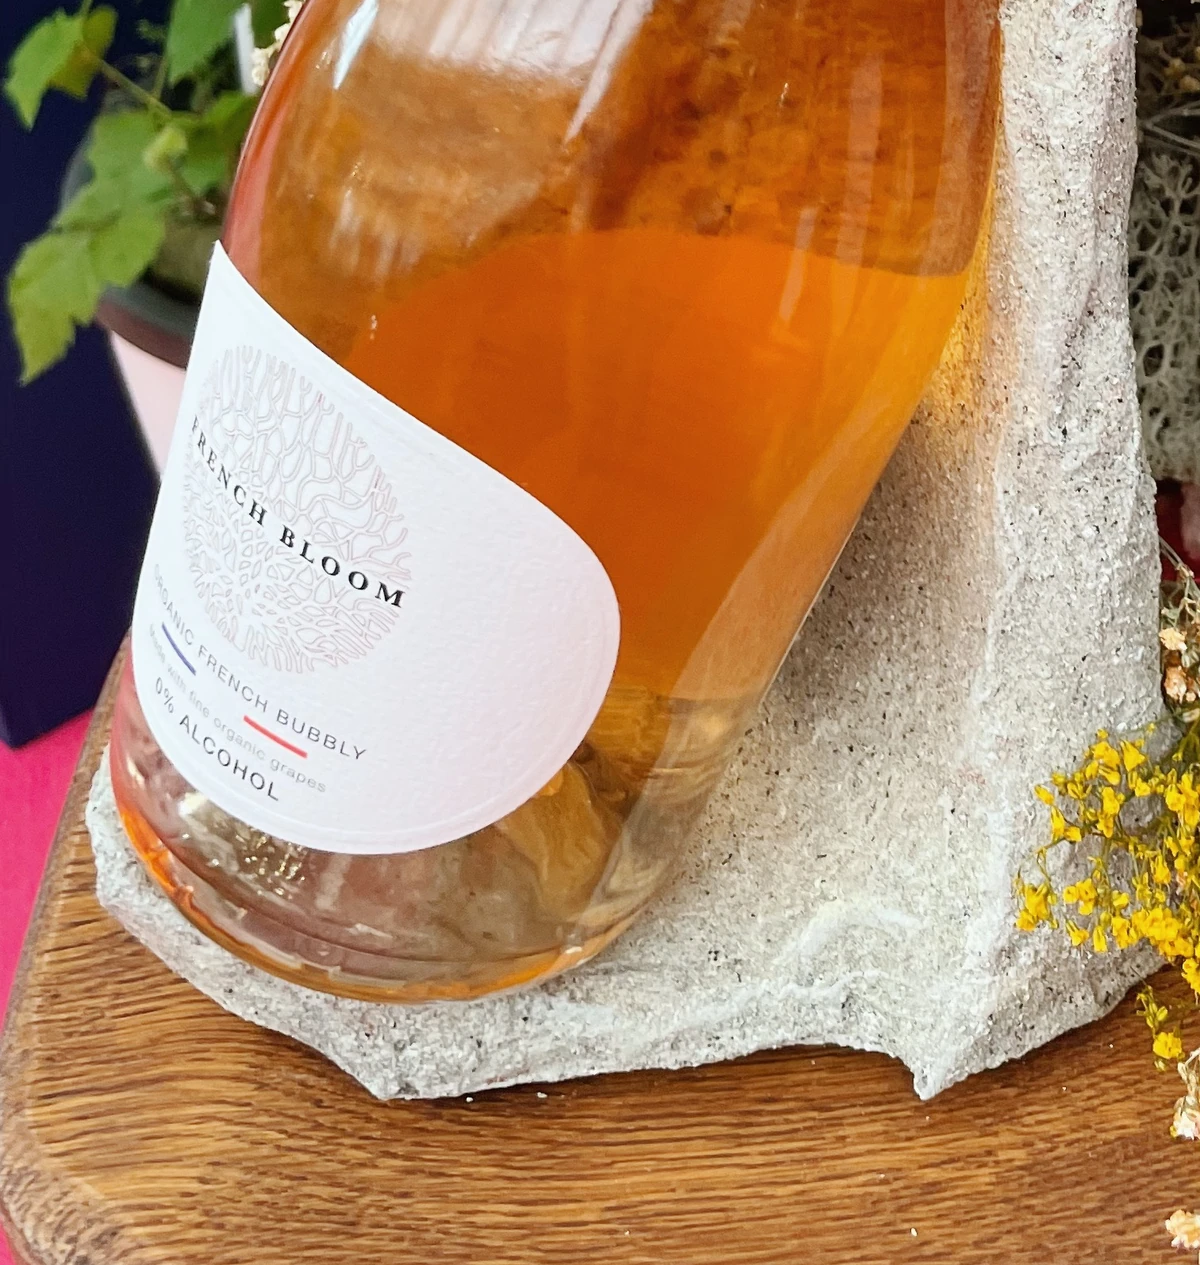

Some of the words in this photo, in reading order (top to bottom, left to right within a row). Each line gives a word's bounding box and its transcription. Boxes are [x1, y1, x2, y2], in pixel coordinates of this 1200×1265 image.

[191, 414, 267, 526] FRENCH
[279, 524, 406, 608] BLOOM
[154, 563, 194, 646] ORGANIC
[198, 644, 268, 713] FRENCH
[276, 709, 367, 760] BUBBLY
[155, 676, 174, 714] 0%
[180, 714, 280, 801] ALCOHOL
[214, 717, 266, 761] organic
[270, 758, 326, 793] grapes
